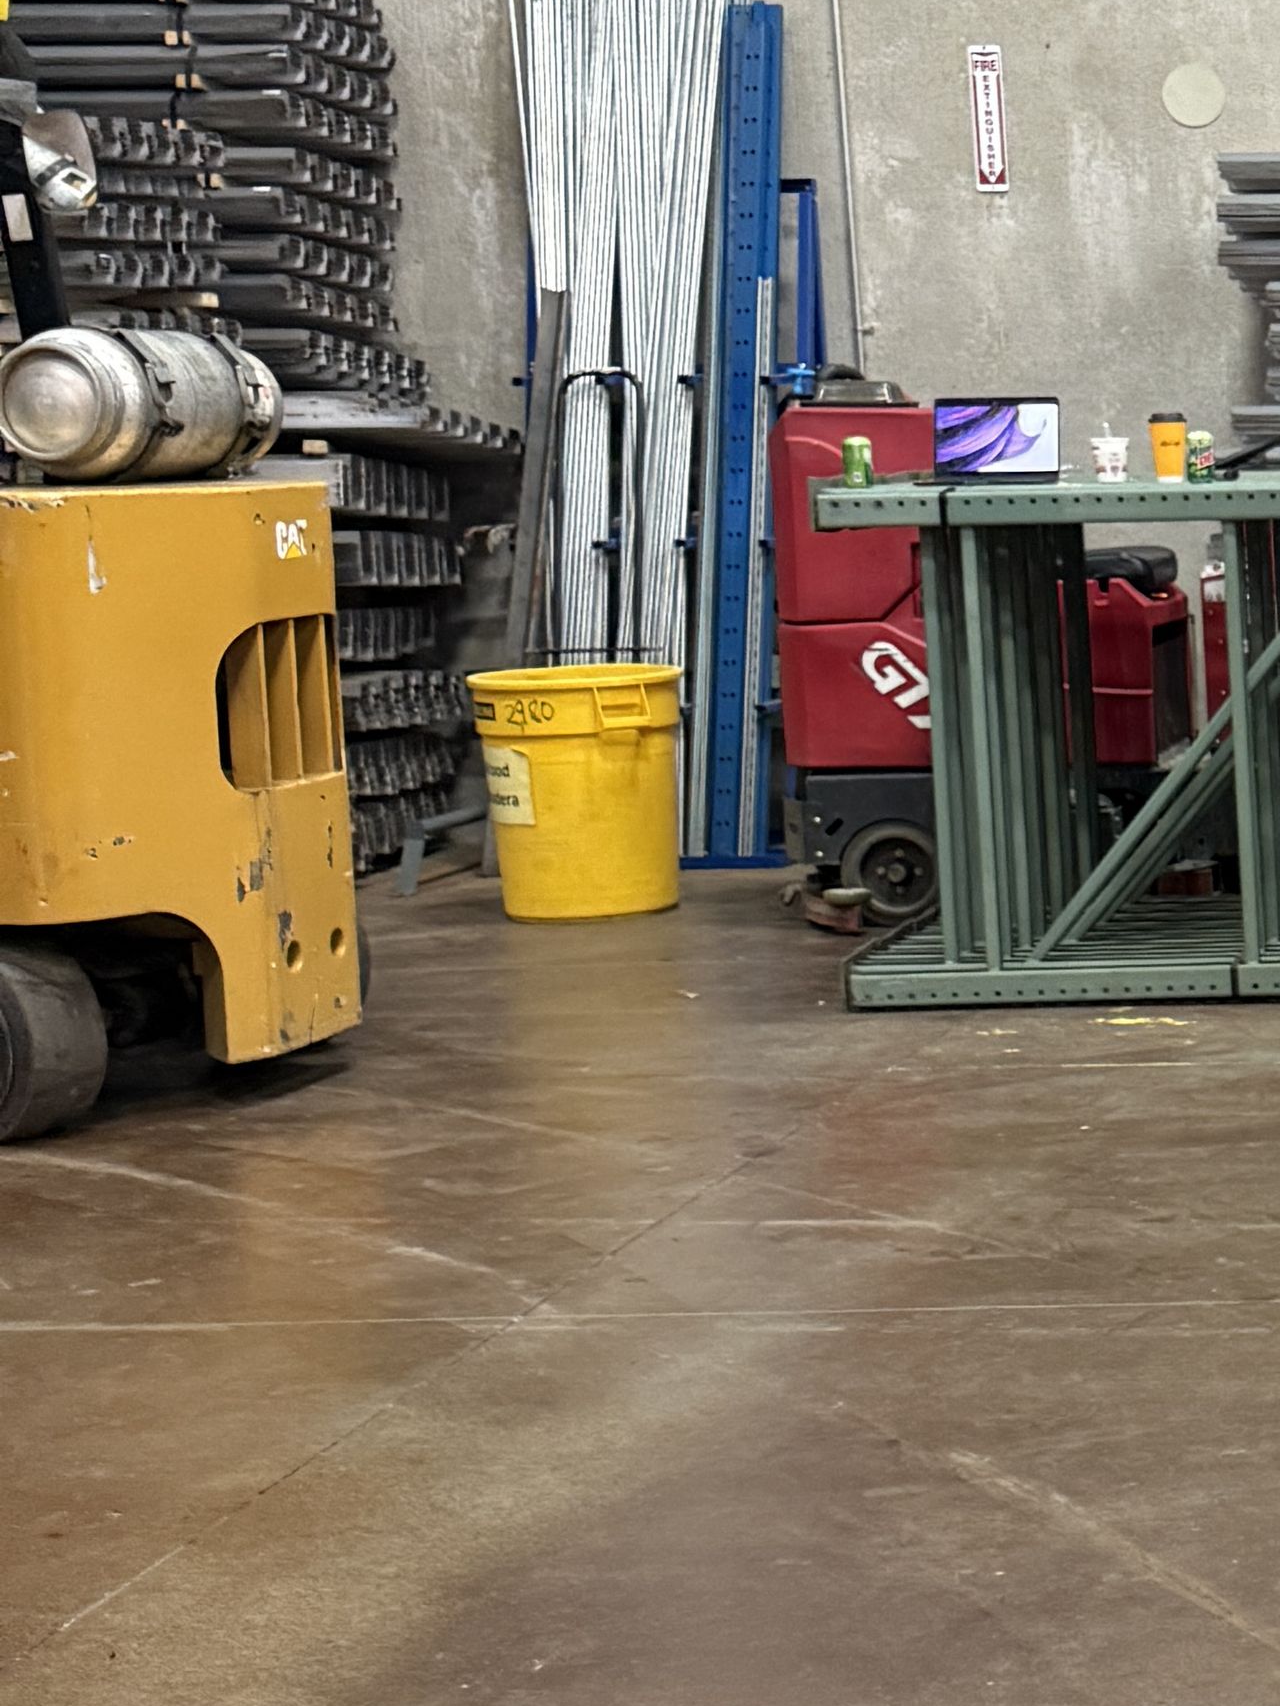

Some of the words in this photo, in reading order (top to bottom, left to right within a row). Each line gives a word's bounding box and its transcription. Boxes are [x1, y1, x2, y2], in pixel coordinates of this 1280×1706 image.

[974, 59, 997, 72] FIRE
[982, 74, 997, 178] EXTINGUISHER
[275, 518, 308, 560] CAT
